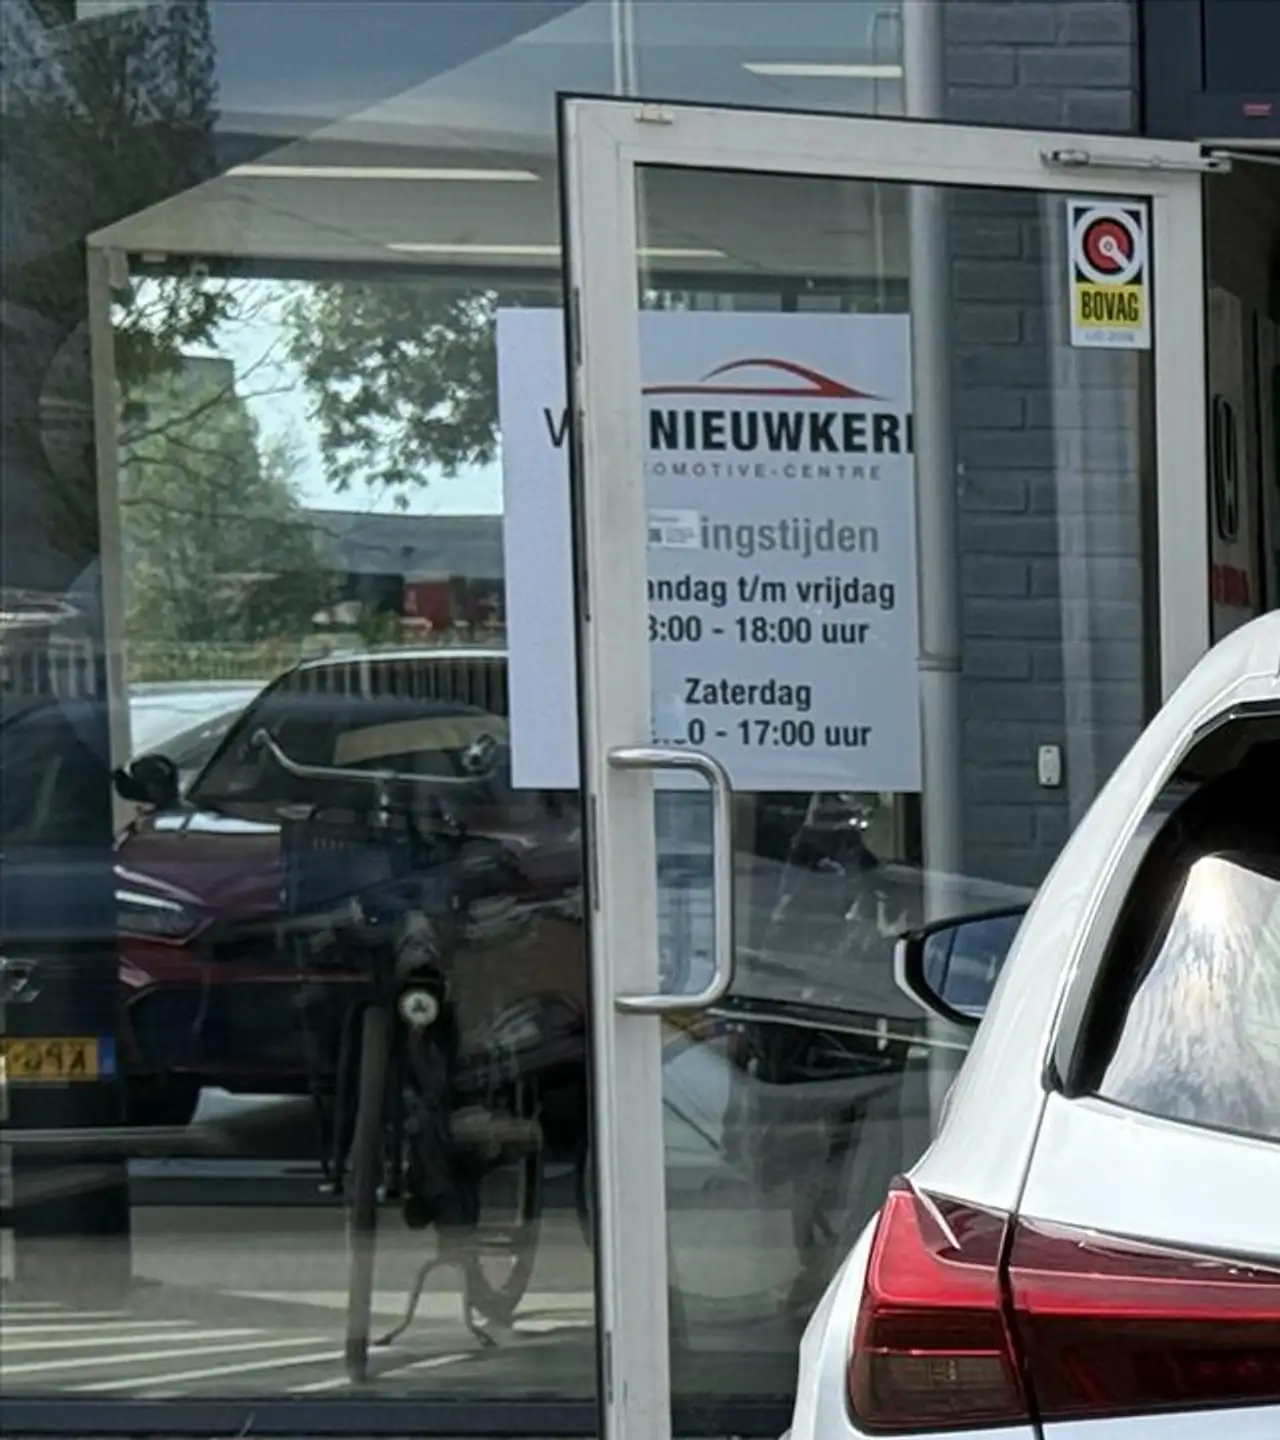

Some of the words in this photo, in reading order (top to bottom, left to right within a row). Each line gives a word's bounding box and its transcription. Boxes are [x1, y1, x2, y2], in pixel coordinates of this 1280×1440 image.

[1081, 290, 1139, 322] BOVAG
[643, 462, 882, 481] OMOTIVE-CENTRE
[699, 516, 880, 558] ingstijden
[737, 573, 788, 604] t/m
[796, 575, 896, 611] vrijdag
[735, 616, 812, 643] 18:00
[821, 623, 870, 644] uur
[684, 677, 813, 712] Zaterdag
[738, 720, 816, 746] 17:00
[825, 726, 872, 747] uur
